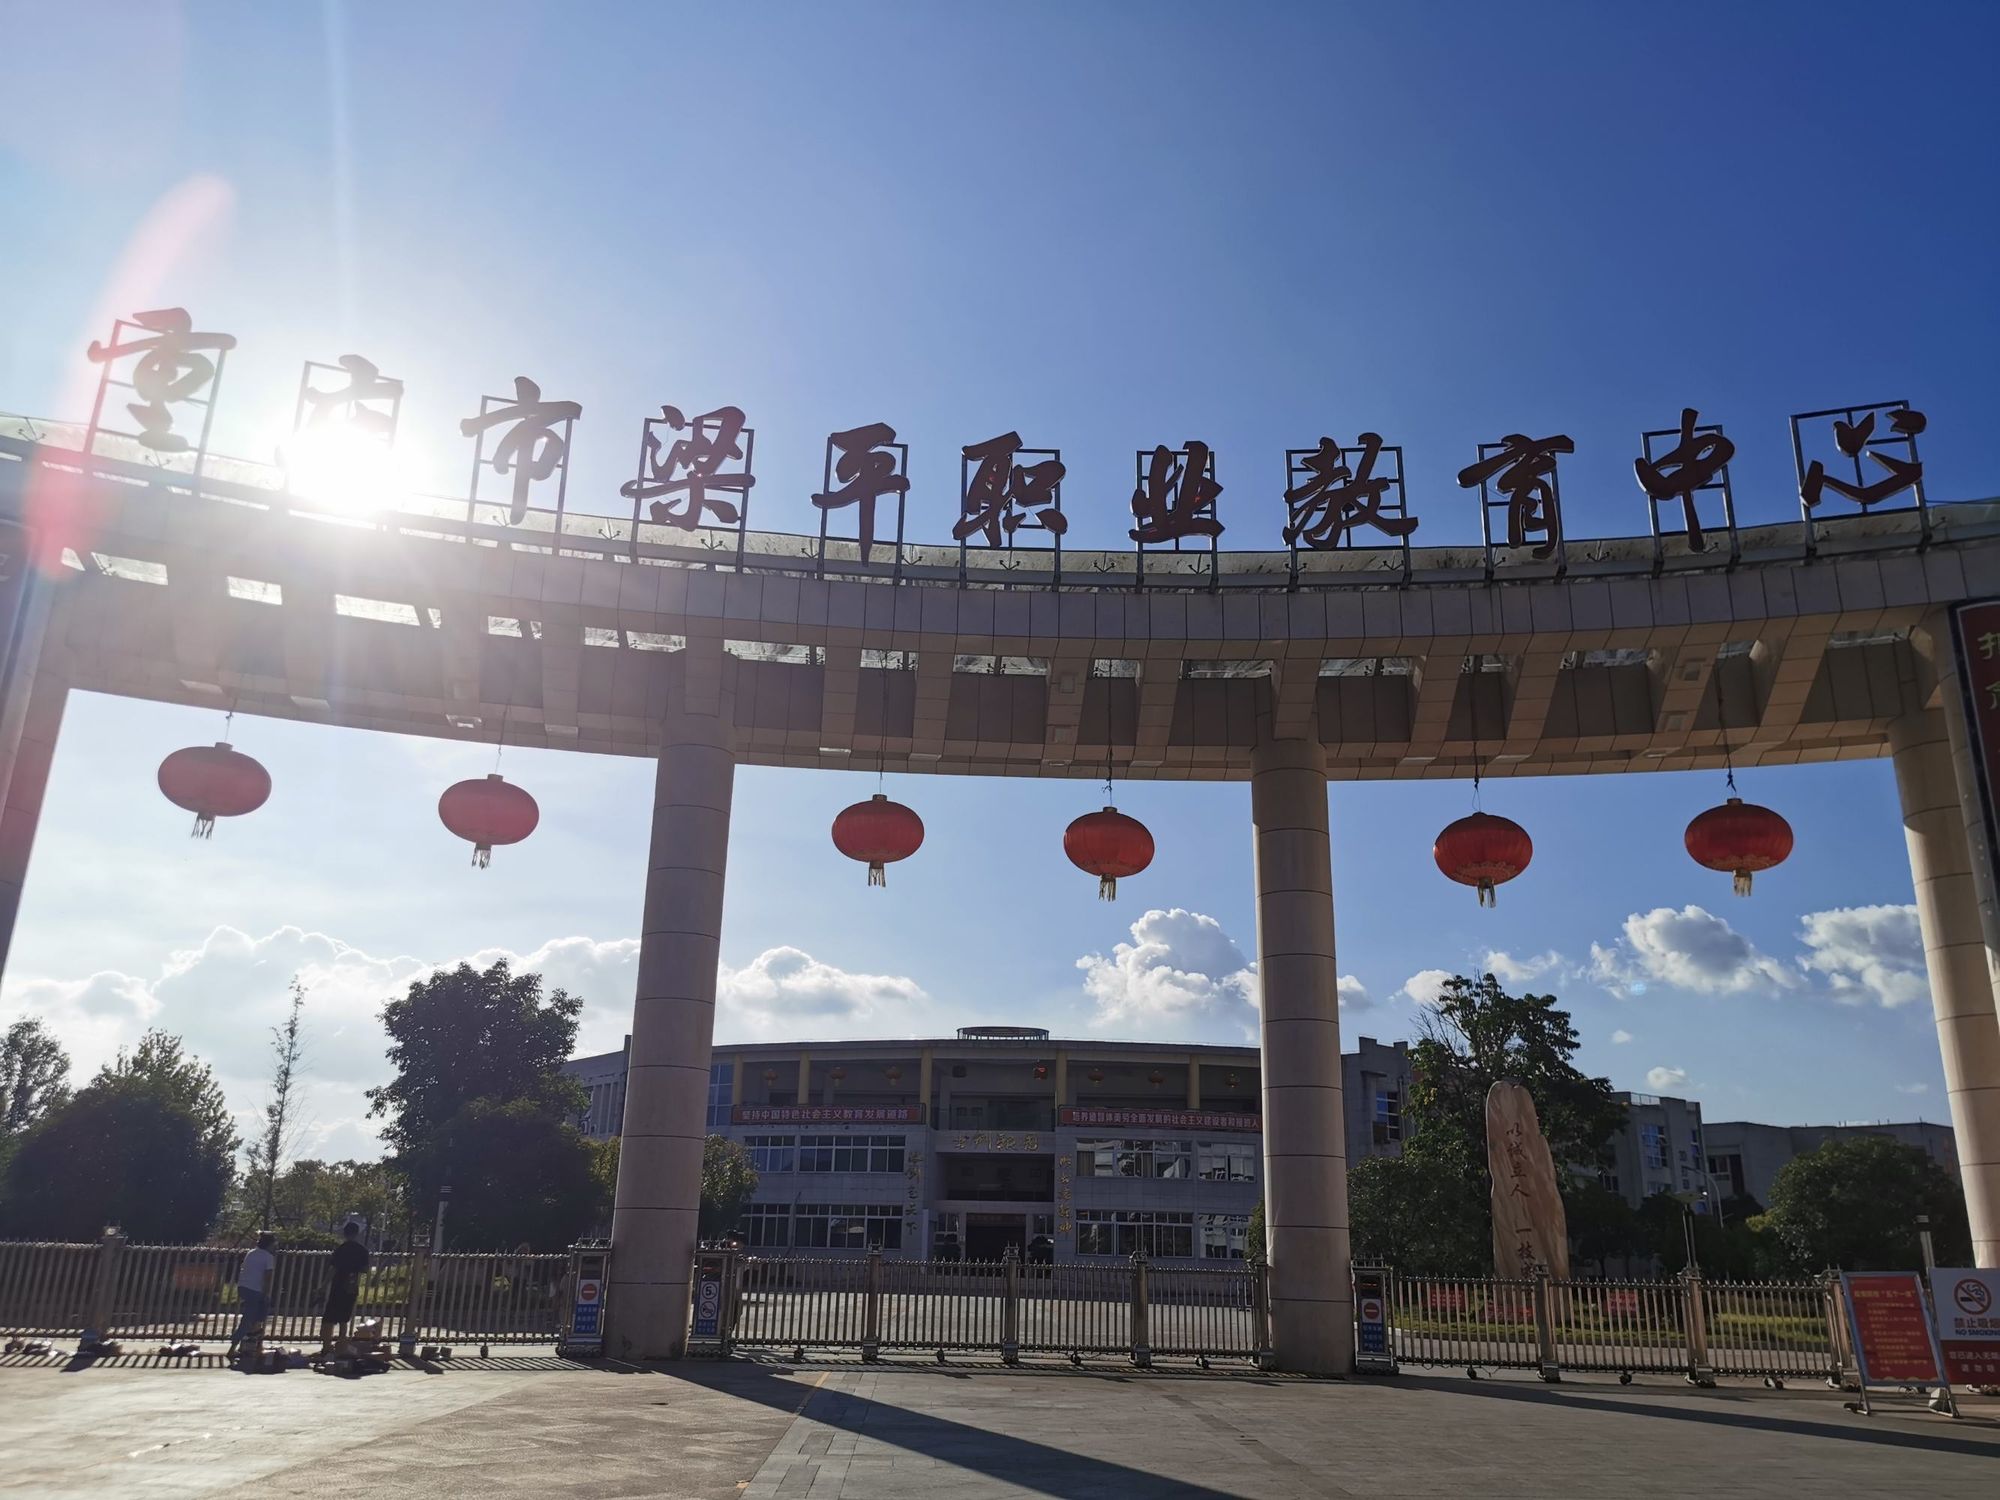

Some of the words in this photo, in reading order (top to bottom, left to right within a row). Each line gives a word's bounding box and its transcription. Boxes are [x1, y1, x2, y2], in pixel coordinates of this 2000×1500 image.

[741, 1108, 909, 1121] 坚持中国特色社会主义教育发展道路
